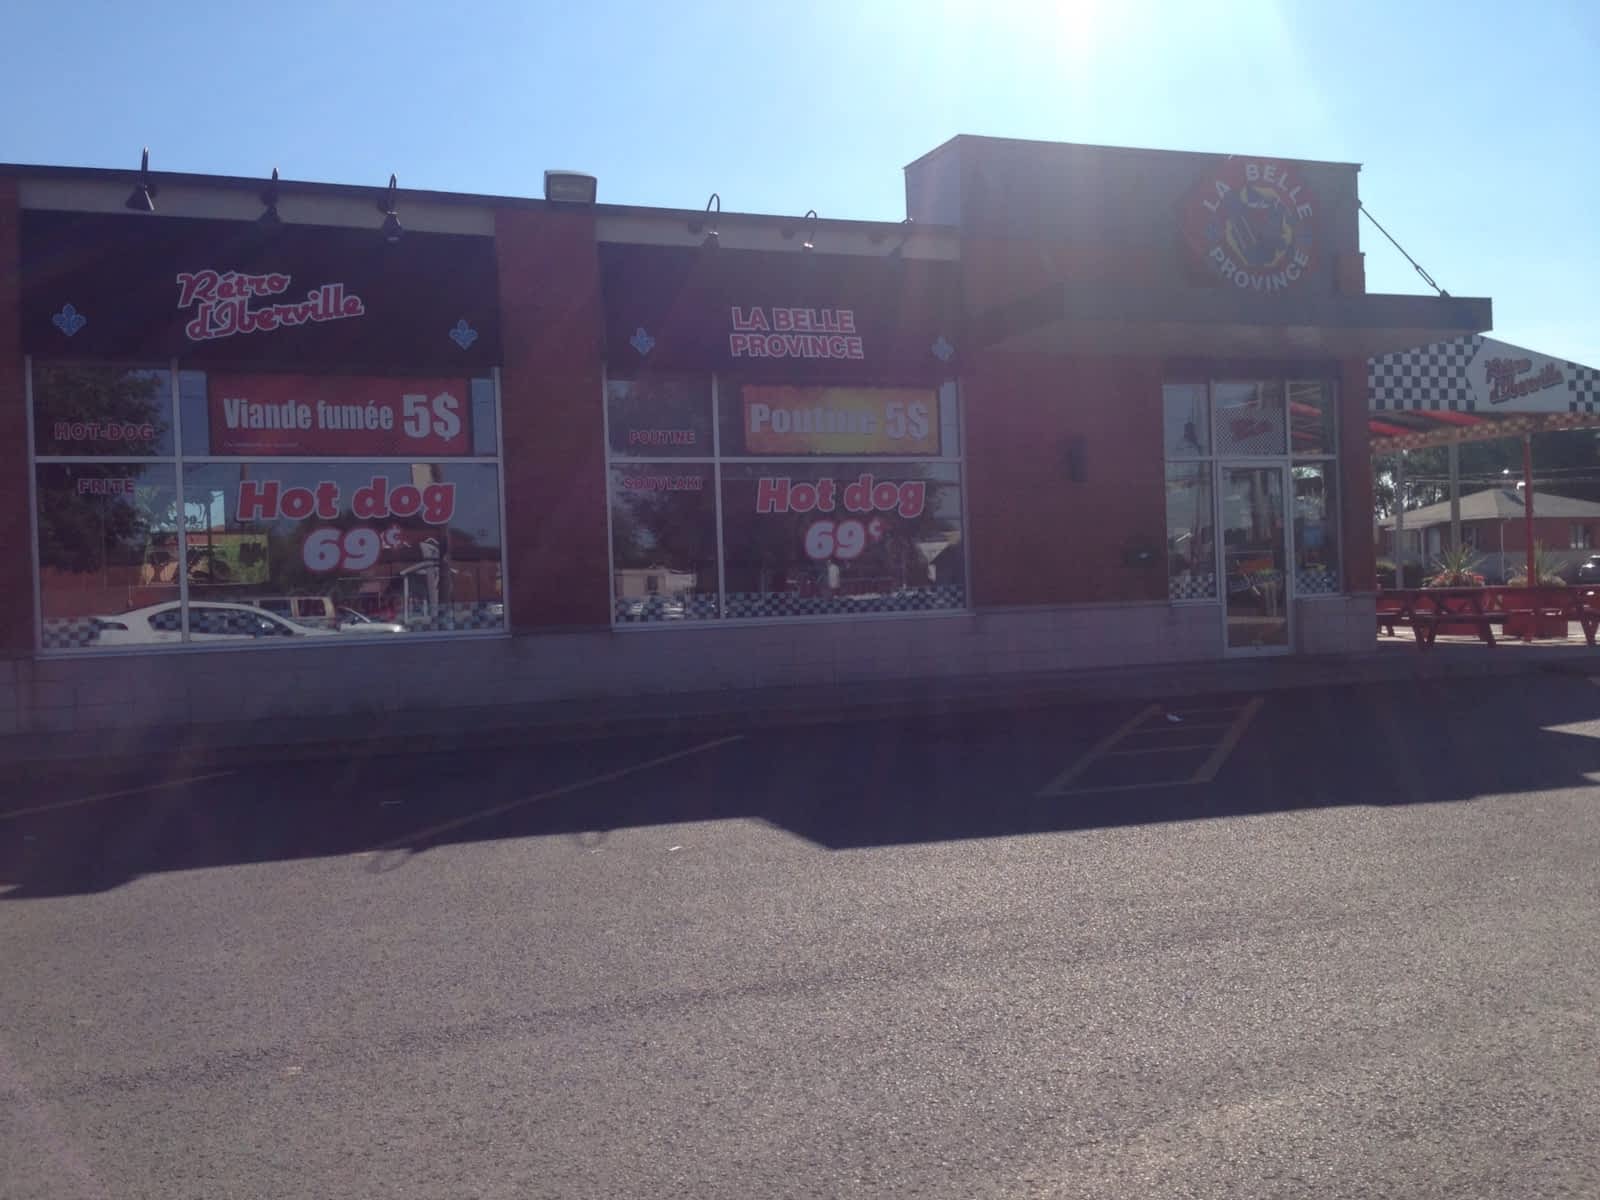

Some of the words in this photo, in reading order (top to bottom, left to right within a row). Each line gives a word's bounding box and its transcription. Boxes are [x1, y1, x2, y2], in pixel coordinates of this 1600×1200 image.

[1203, 180, 1231, 212] LA
[1245, 164, 1313, 219] BELLE
[176, 270, 292, 308] Rétro
[1209, 247, 1309, 289] PROVINCE
[731, 306, 770, 331] LA
[772, 307, 856, 333] BELLE
[729, 334, 865, 360] PROVINCE
[54, 422, 154, 441] HOT-DOG
[223, 398, 313, 430] Viande
[316, 400, 394, 431] fumée
[402, 392, 461, 441] 5$
[236, 480, 341, 522] Hot
[352, 475, 457, 525] dog
[756, 477, 837, 513] Hot
[844, 472, 926, 519] dog
